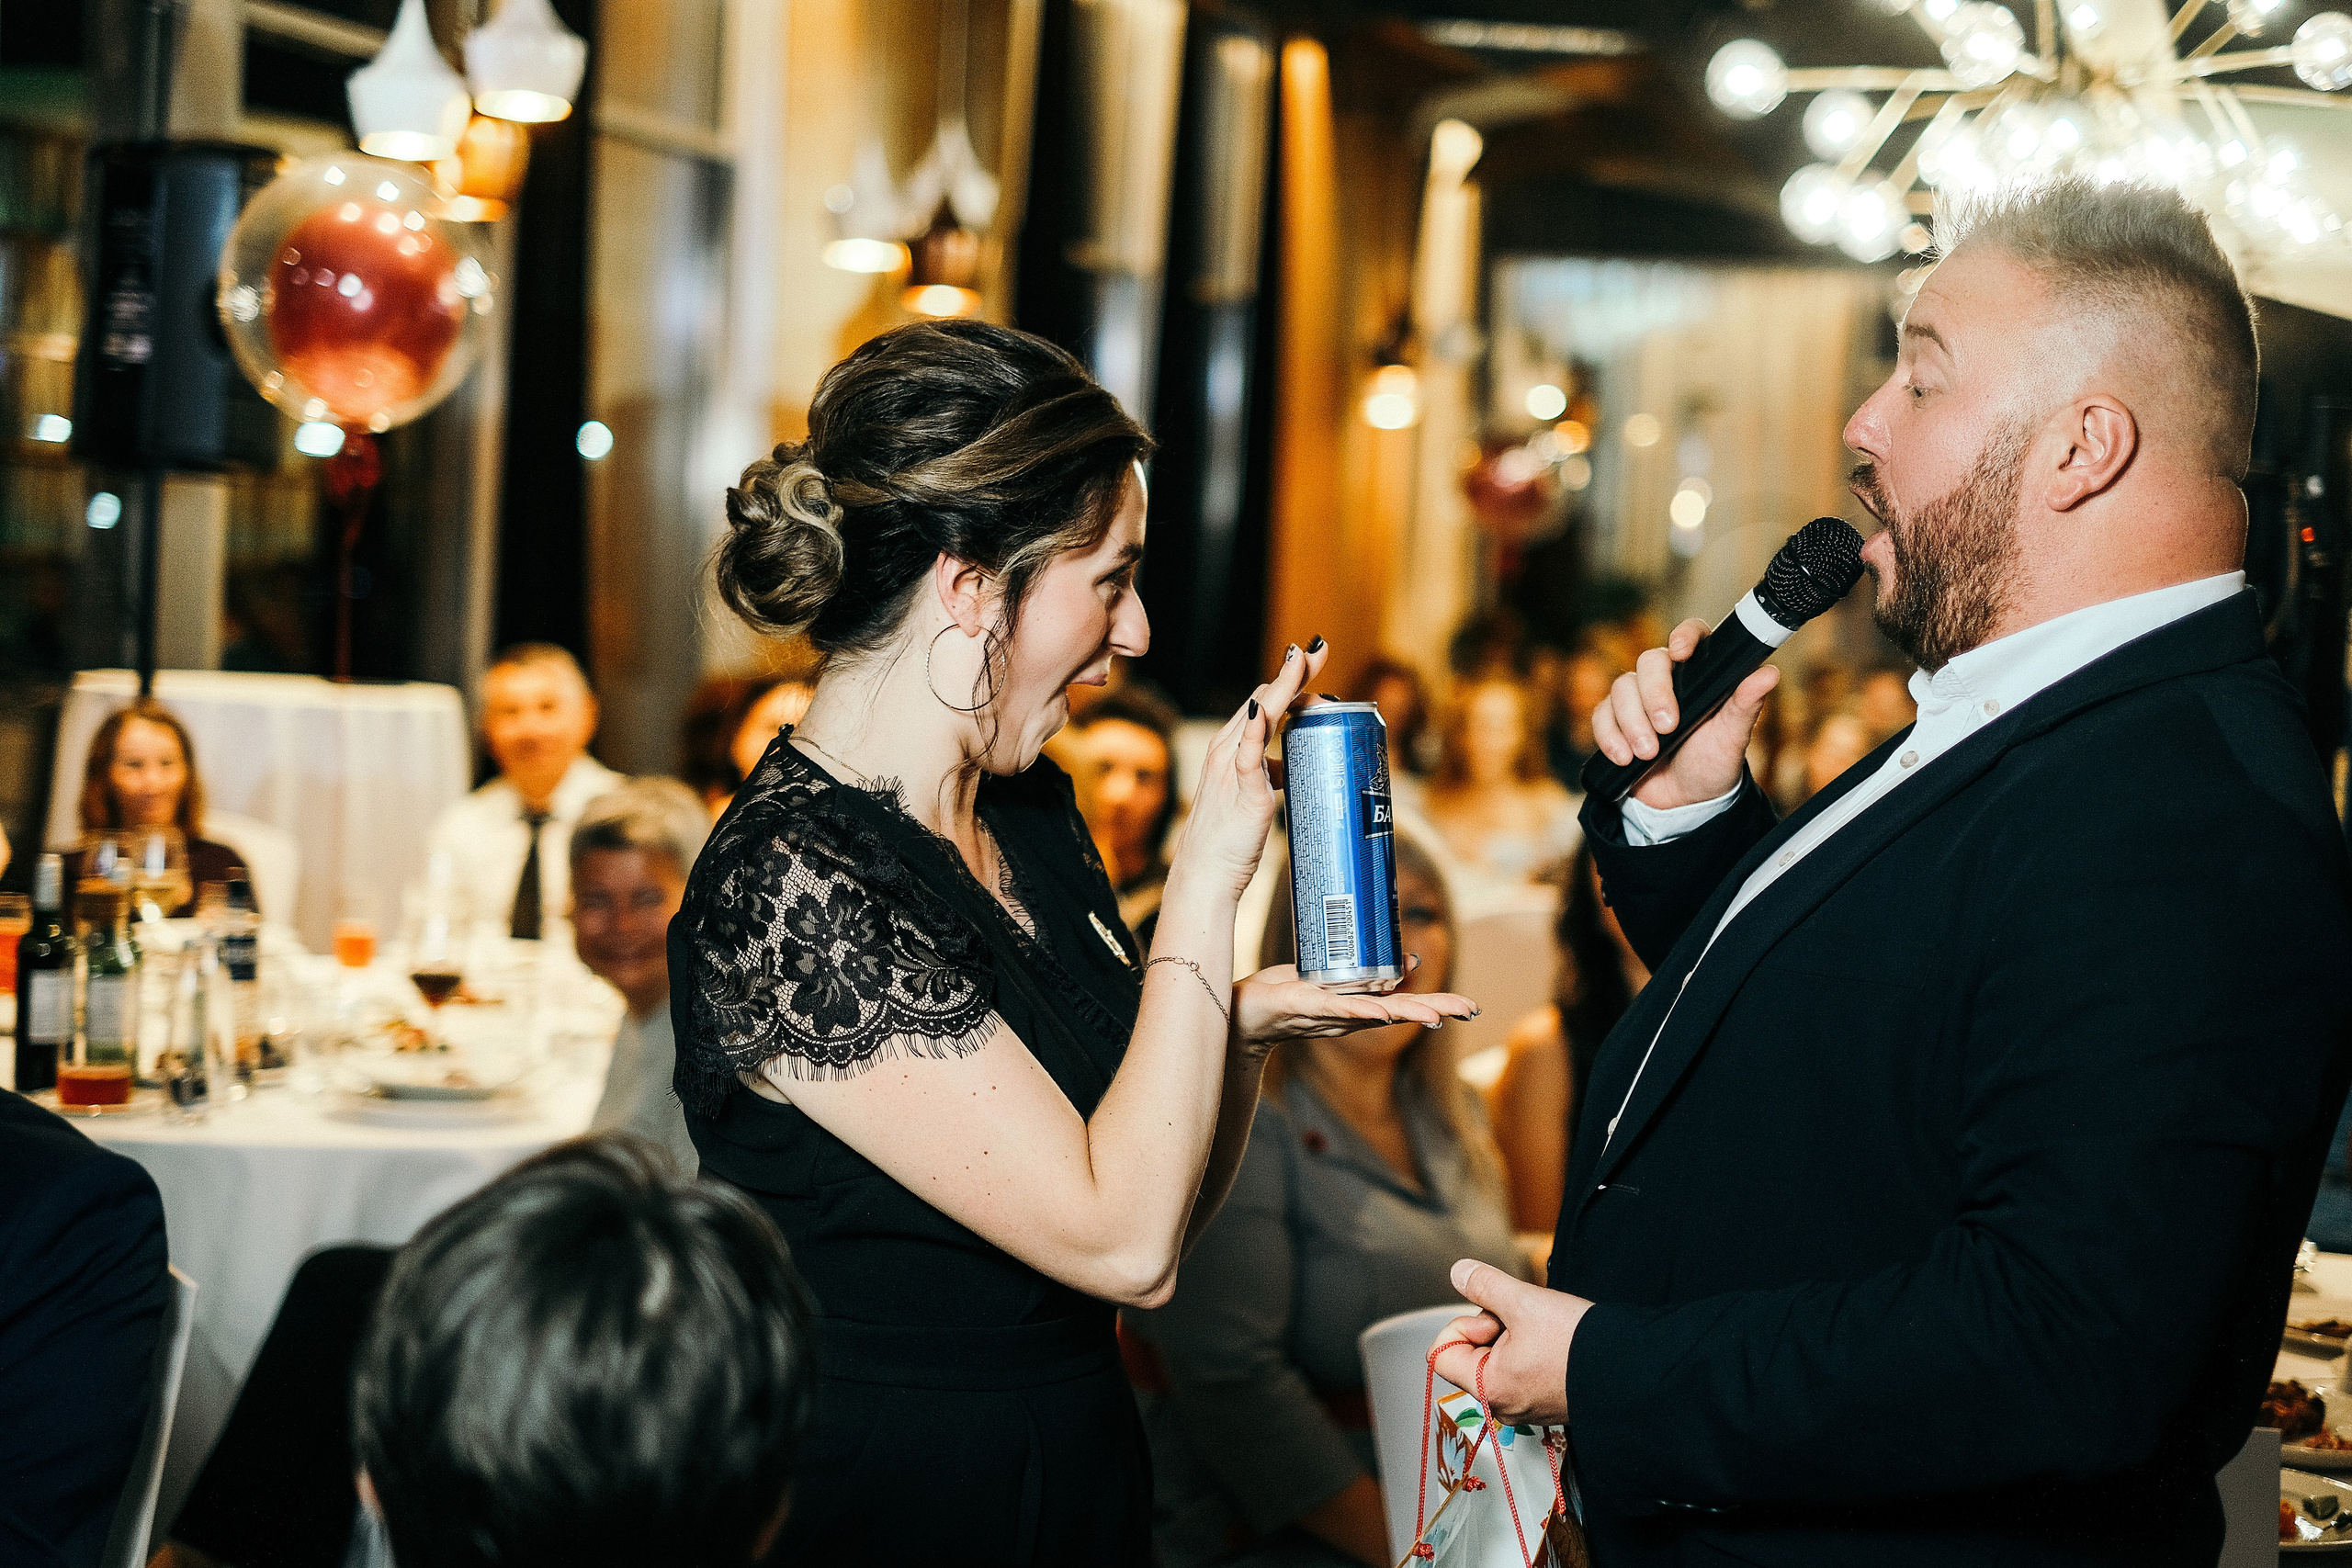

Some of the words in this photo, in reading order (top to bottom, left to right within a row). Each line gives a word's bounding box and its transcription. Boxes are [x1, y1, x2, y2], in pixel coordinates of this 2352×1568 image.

[1373, 805, 1393, 823] БА
[1345, 901, 1353, 928] 200451
[1347, 931, 1355, 957] 600682
